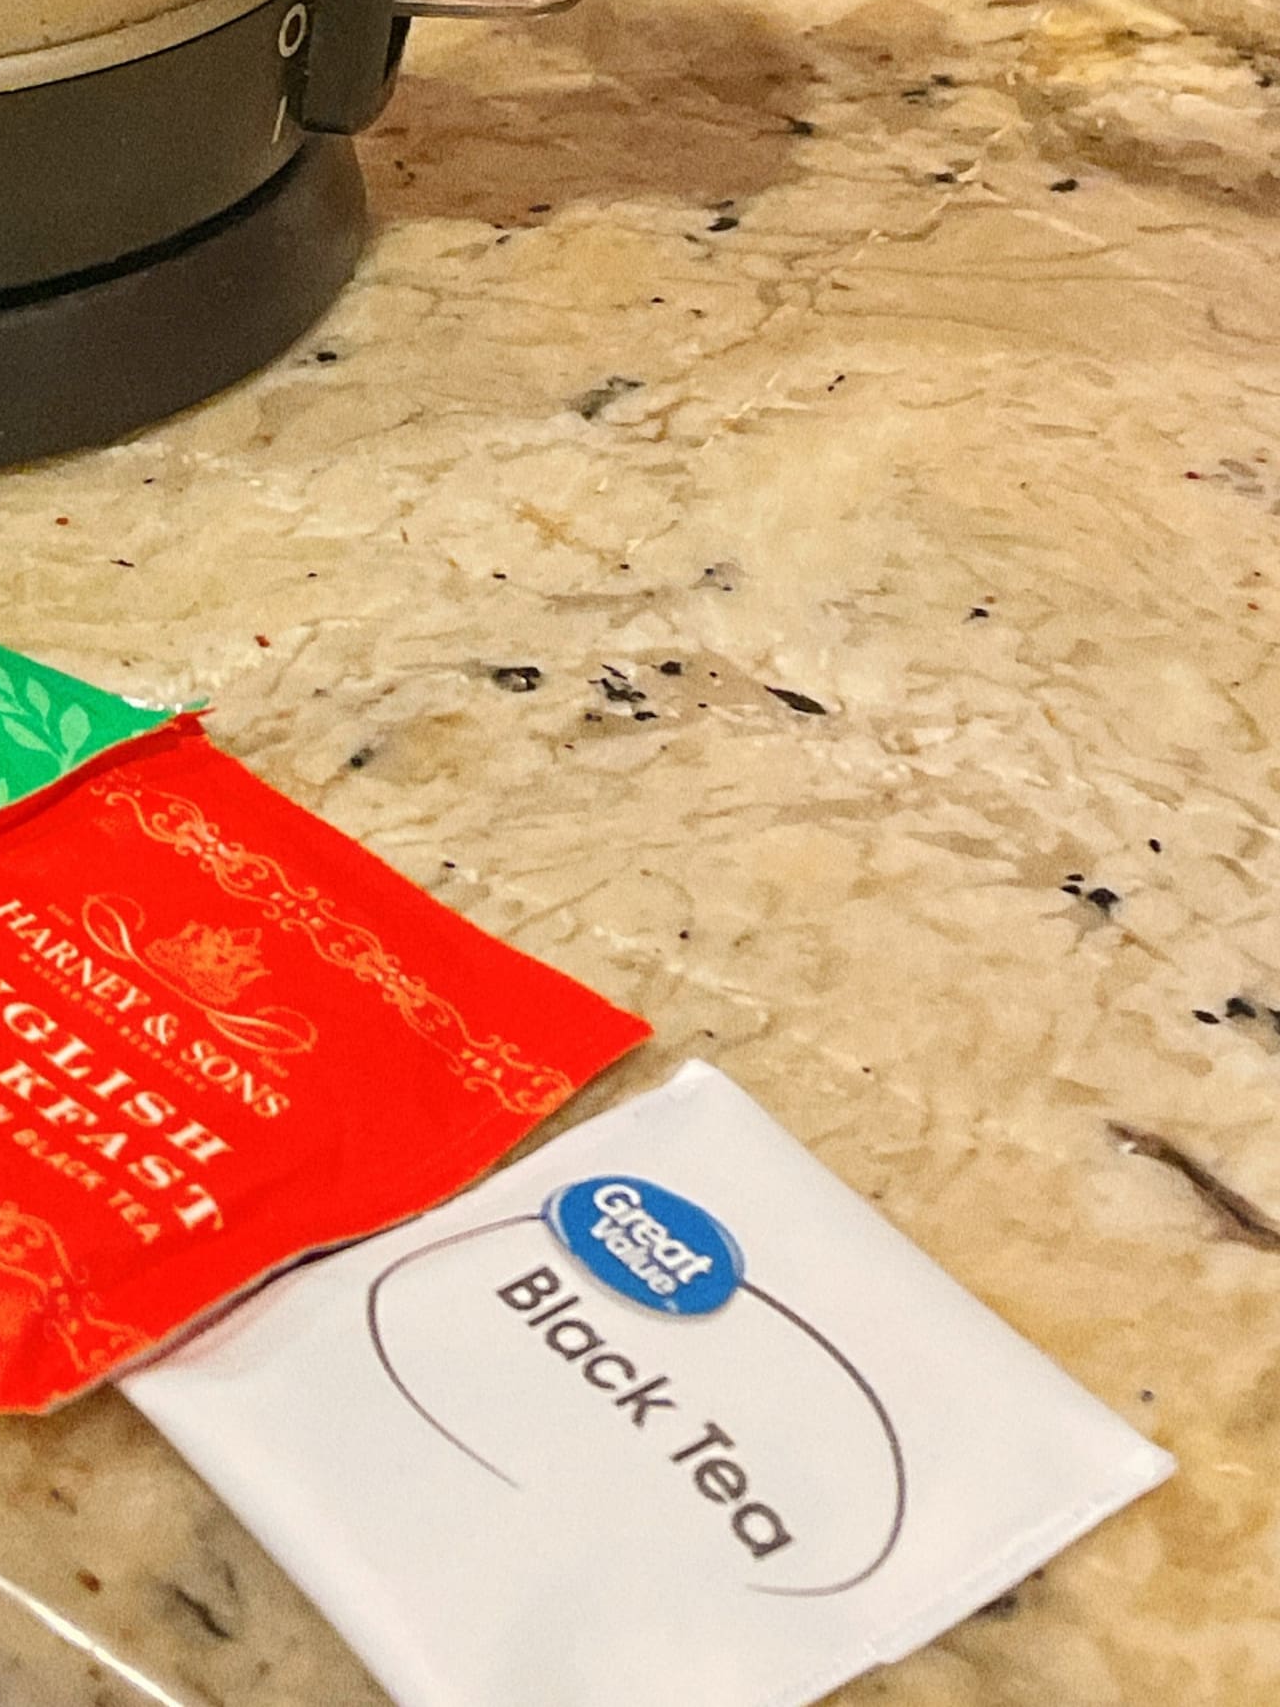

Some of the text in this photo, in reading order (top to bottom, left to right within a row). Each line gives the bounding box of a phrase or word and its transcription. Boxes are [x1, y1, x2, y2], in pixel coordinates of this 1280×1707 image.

[143, 1012, 179, 1045] &
[179, 1039, 291, 1119] SONS
[12, 1128, 108, 1190] BLACK
[107, 1189, 161, 1244] TEA
[589, 1183, 714, 1296] Great Value
[496, 1264, 796, 1562] Black Tea
